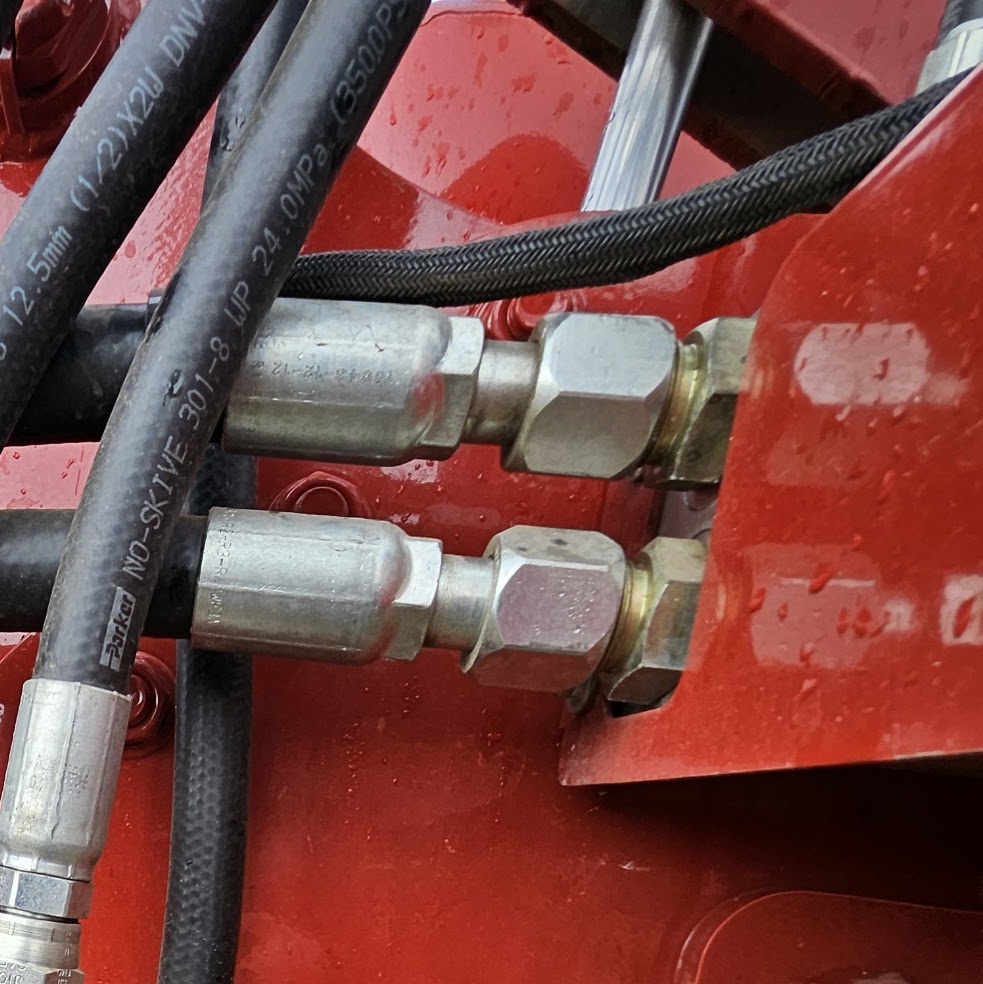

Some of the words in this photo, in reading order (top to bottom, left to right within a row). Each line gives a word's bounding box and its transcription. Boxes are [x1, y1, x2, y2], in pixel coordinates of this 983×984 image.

[3, 225, 72, 326] 12.5mm
[102, 588, 135, 669] Parker
[122, 436, 187, 581] NO-SKIVE
[178, 336, 230, 430] 301-8
[251, 143, 328, 276] 24.0MPa
